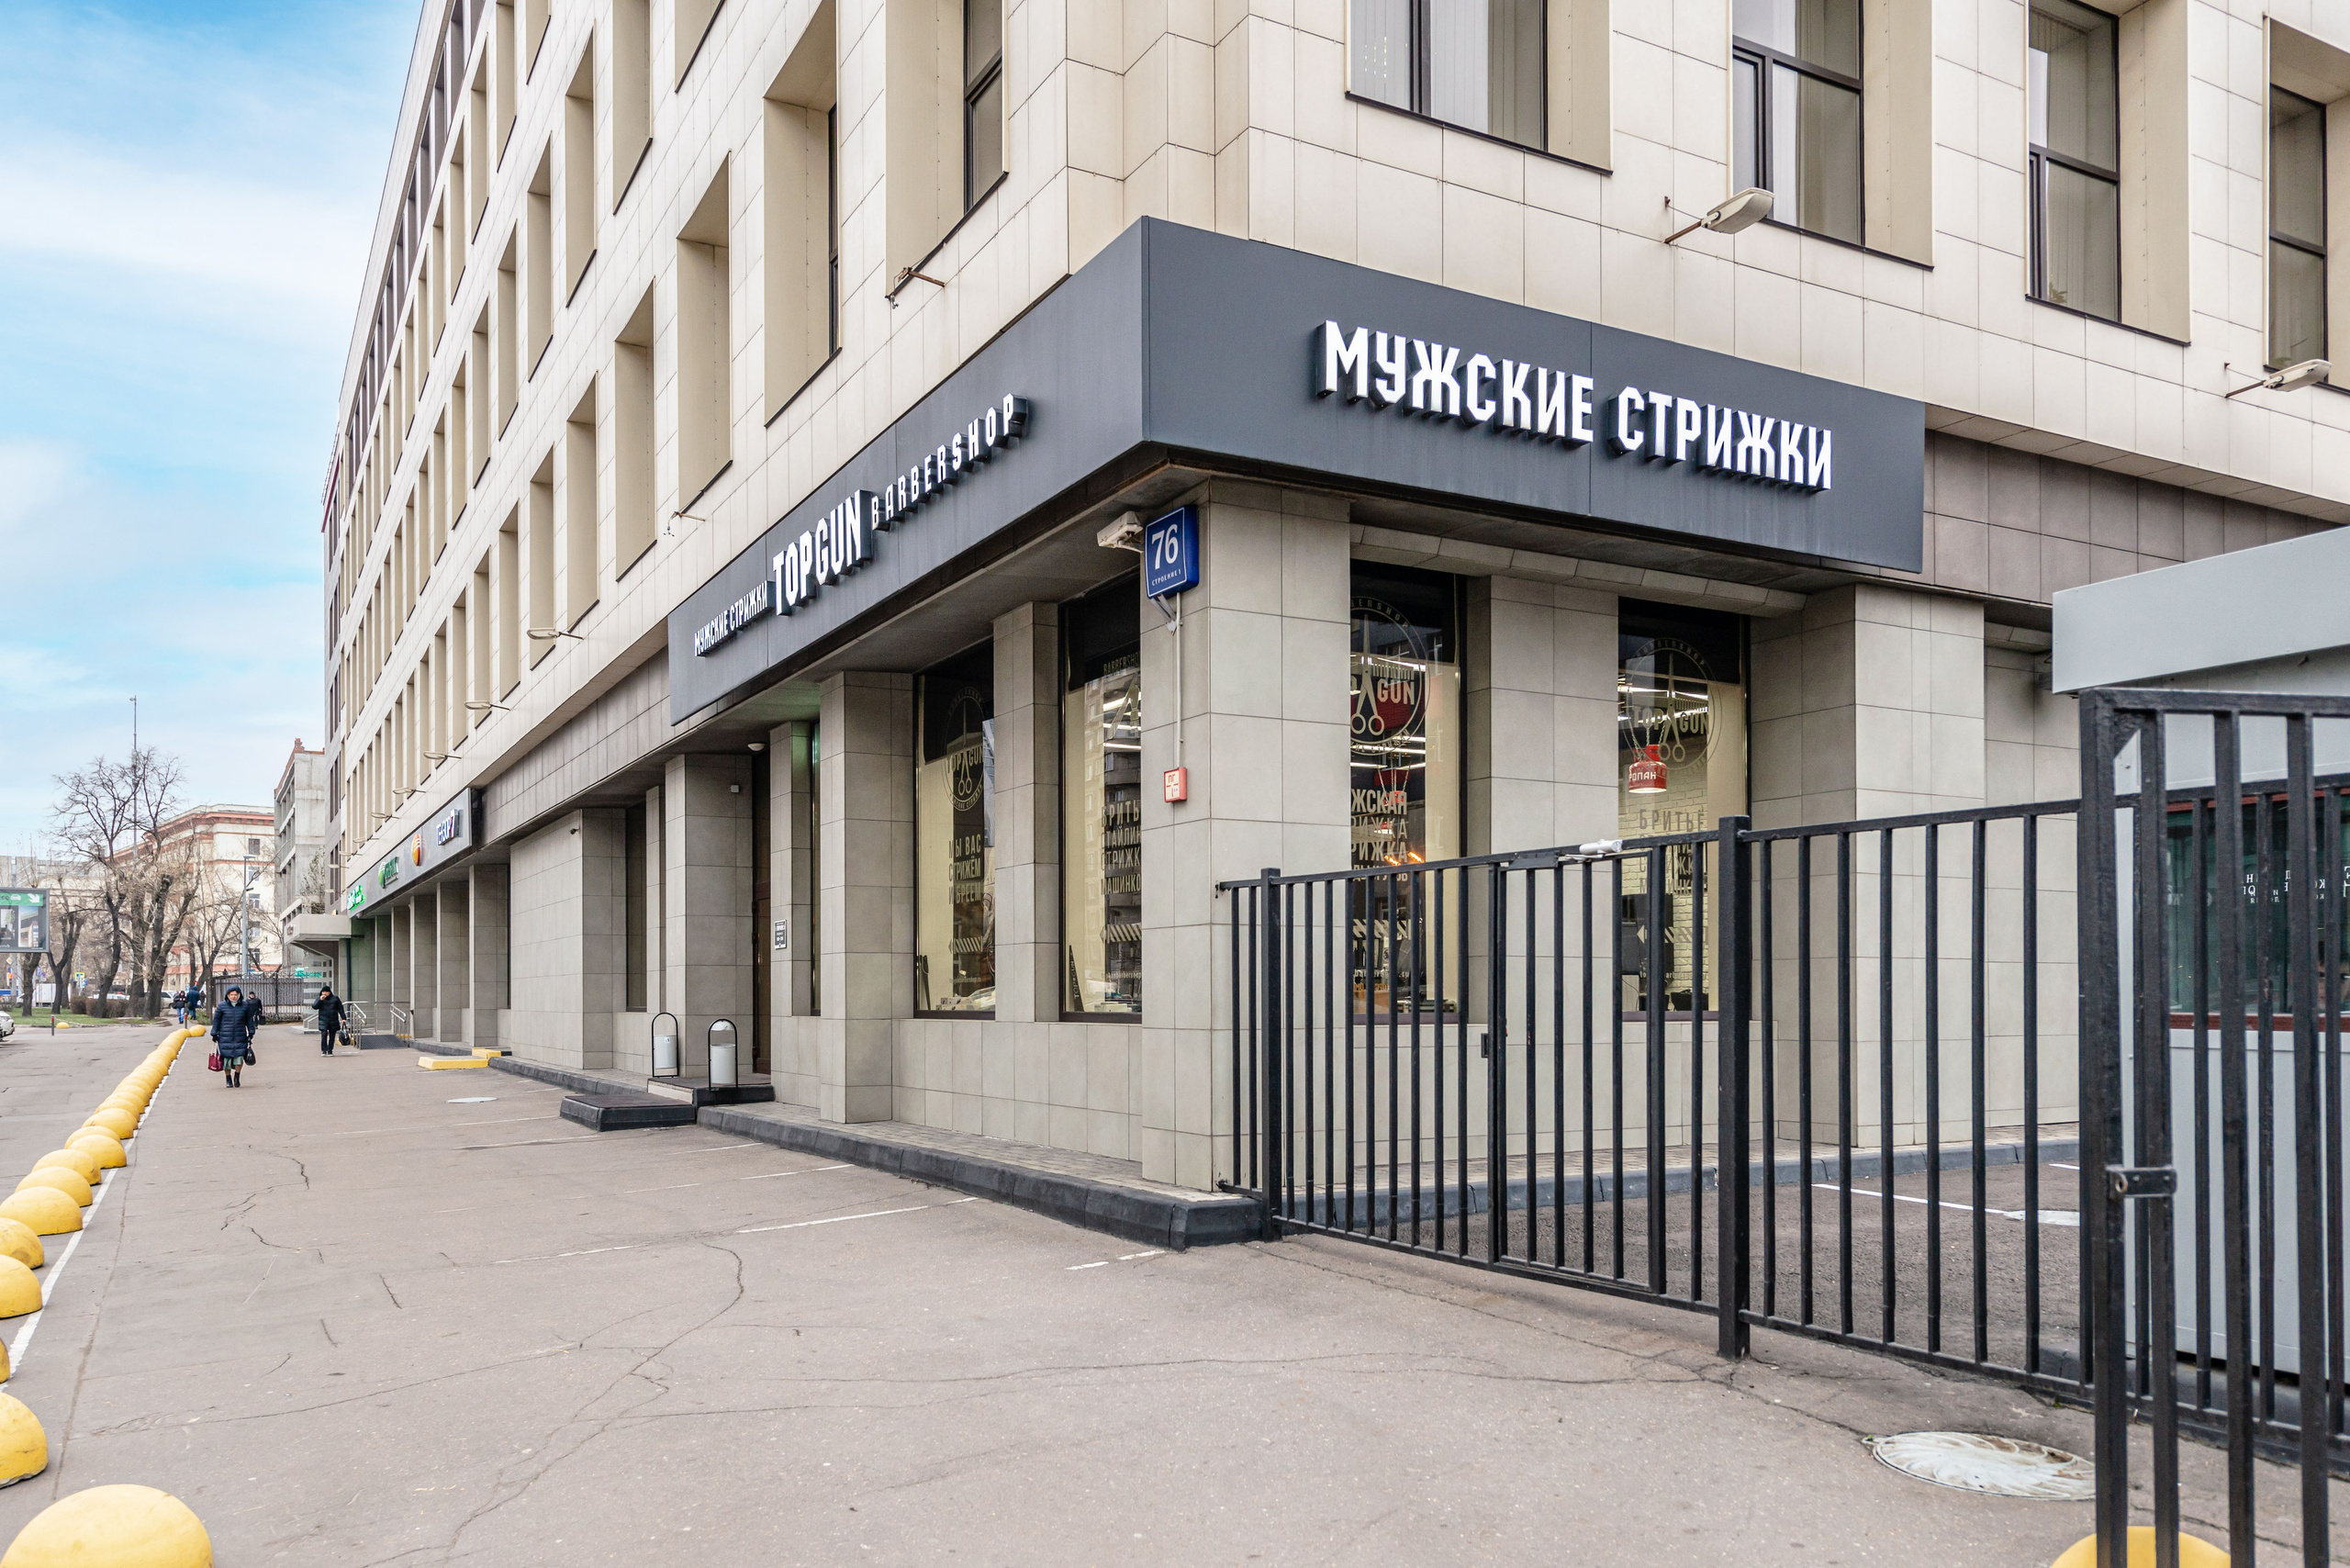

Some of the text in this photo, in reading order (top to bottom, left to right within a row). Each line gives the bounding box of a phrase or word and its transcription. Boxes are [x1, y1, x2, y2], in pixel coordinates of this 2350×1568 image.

[1324, 319, 1832, 490] МУЖСКИЕ СТРИЖКИ
[871, 392, 1015, 531] BARBERSHOP
[1151, 523, 1179, 570] 76
[1151, 570, 1178, 587] СТРОЕНИЕ
[694, 579, 768, 657] МУЖСКИЕ СТРИЖКИ
[1377, 678, 1416, 706] GUN
[1633, 705, 1709, 735] TOP GUN
[946, 745, 984, 774] TOP GUN
[1102, 800, 1139, 827] БРИТЬ
[1351, 789, 1408, 815] ЖСКАЯ
[965, 834, 981, 855] ВАС
[948, 857, 981, 881] СТРИЖЁМ
[957, 880, 981, 905] БРЕЕМ
